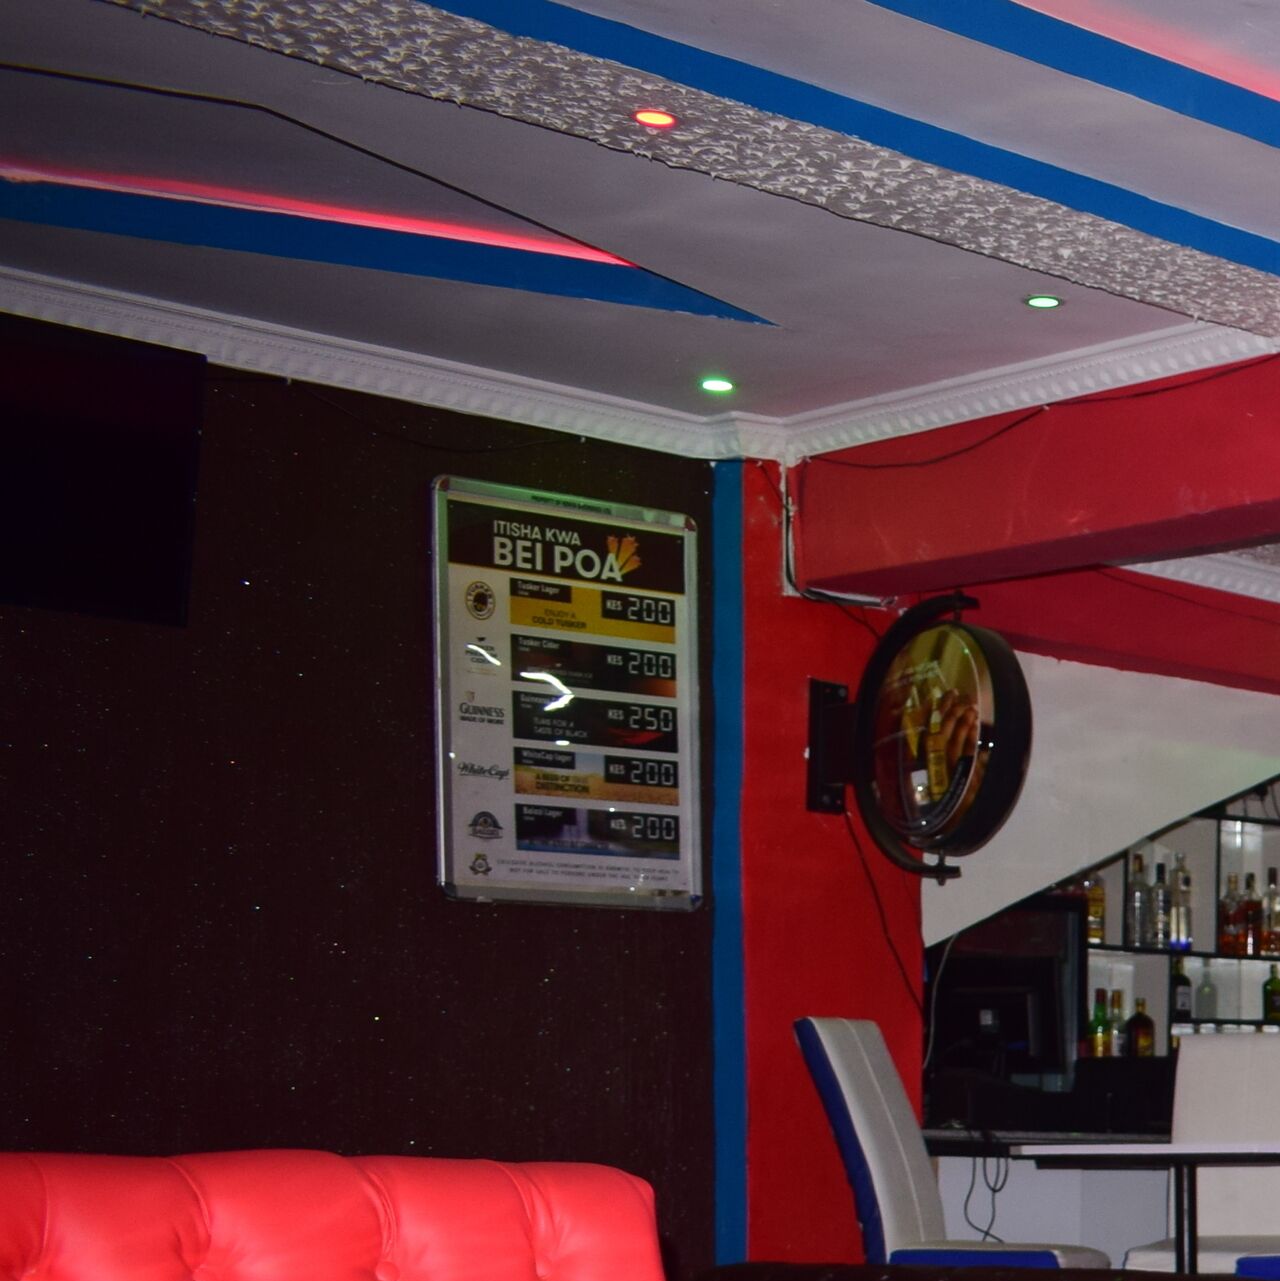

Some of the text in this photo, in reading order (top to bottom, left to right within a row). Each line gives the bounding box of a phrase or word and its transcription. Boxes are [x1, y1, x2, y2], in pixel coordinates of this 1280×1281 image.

[493, 519, 582, 547] ITISHA KWA
[493, 536, 623, 582] BEI POA
[517, 580, 540, 592] Tusker
[541, 584, 560, 597] Lager
[606, 597, 672, 625] KES 200
[606, 652, 673, 679] KES 200
[459, 702, 505, 718] GUINNESS
[607, 706, 673, 733] KES 250
[608, 760, 675, 786] KES 200
[544, 808, 563, 819] Lager
[610, 815, 676, 841] KES 200
